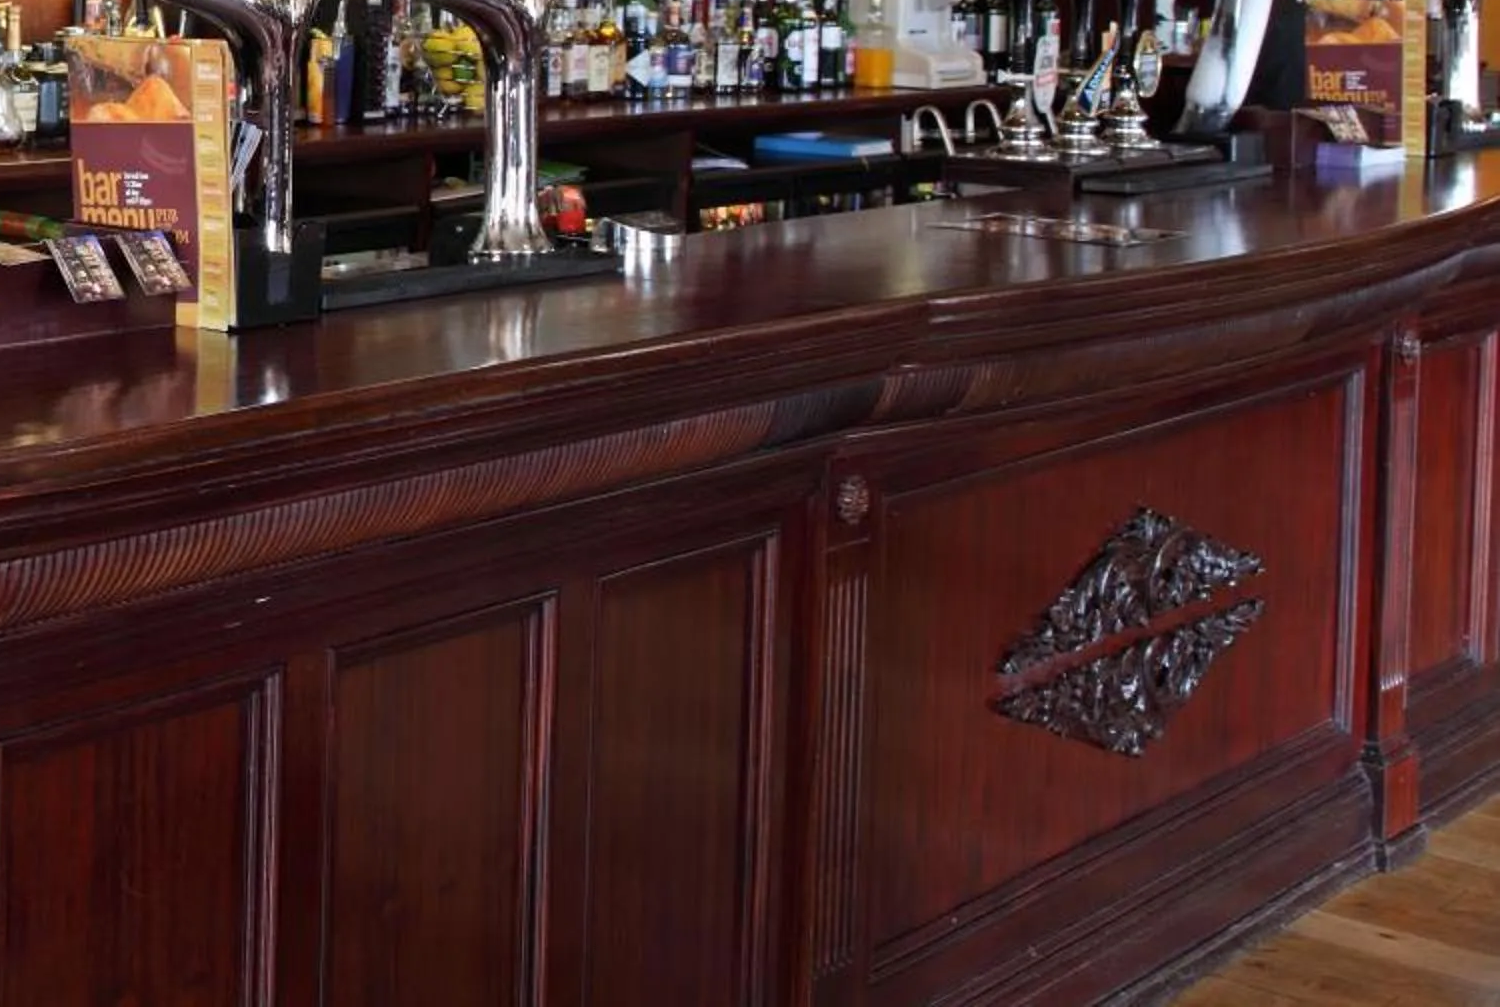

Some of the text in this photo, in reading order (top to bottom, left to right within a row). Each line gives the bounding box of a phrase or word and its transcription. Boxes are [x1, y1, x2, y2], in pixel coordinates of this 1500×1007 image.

[1309, 64, 1343, 92] bar
[77, 158, 122, 206] bar
[81, 206, 155, 230] menu
